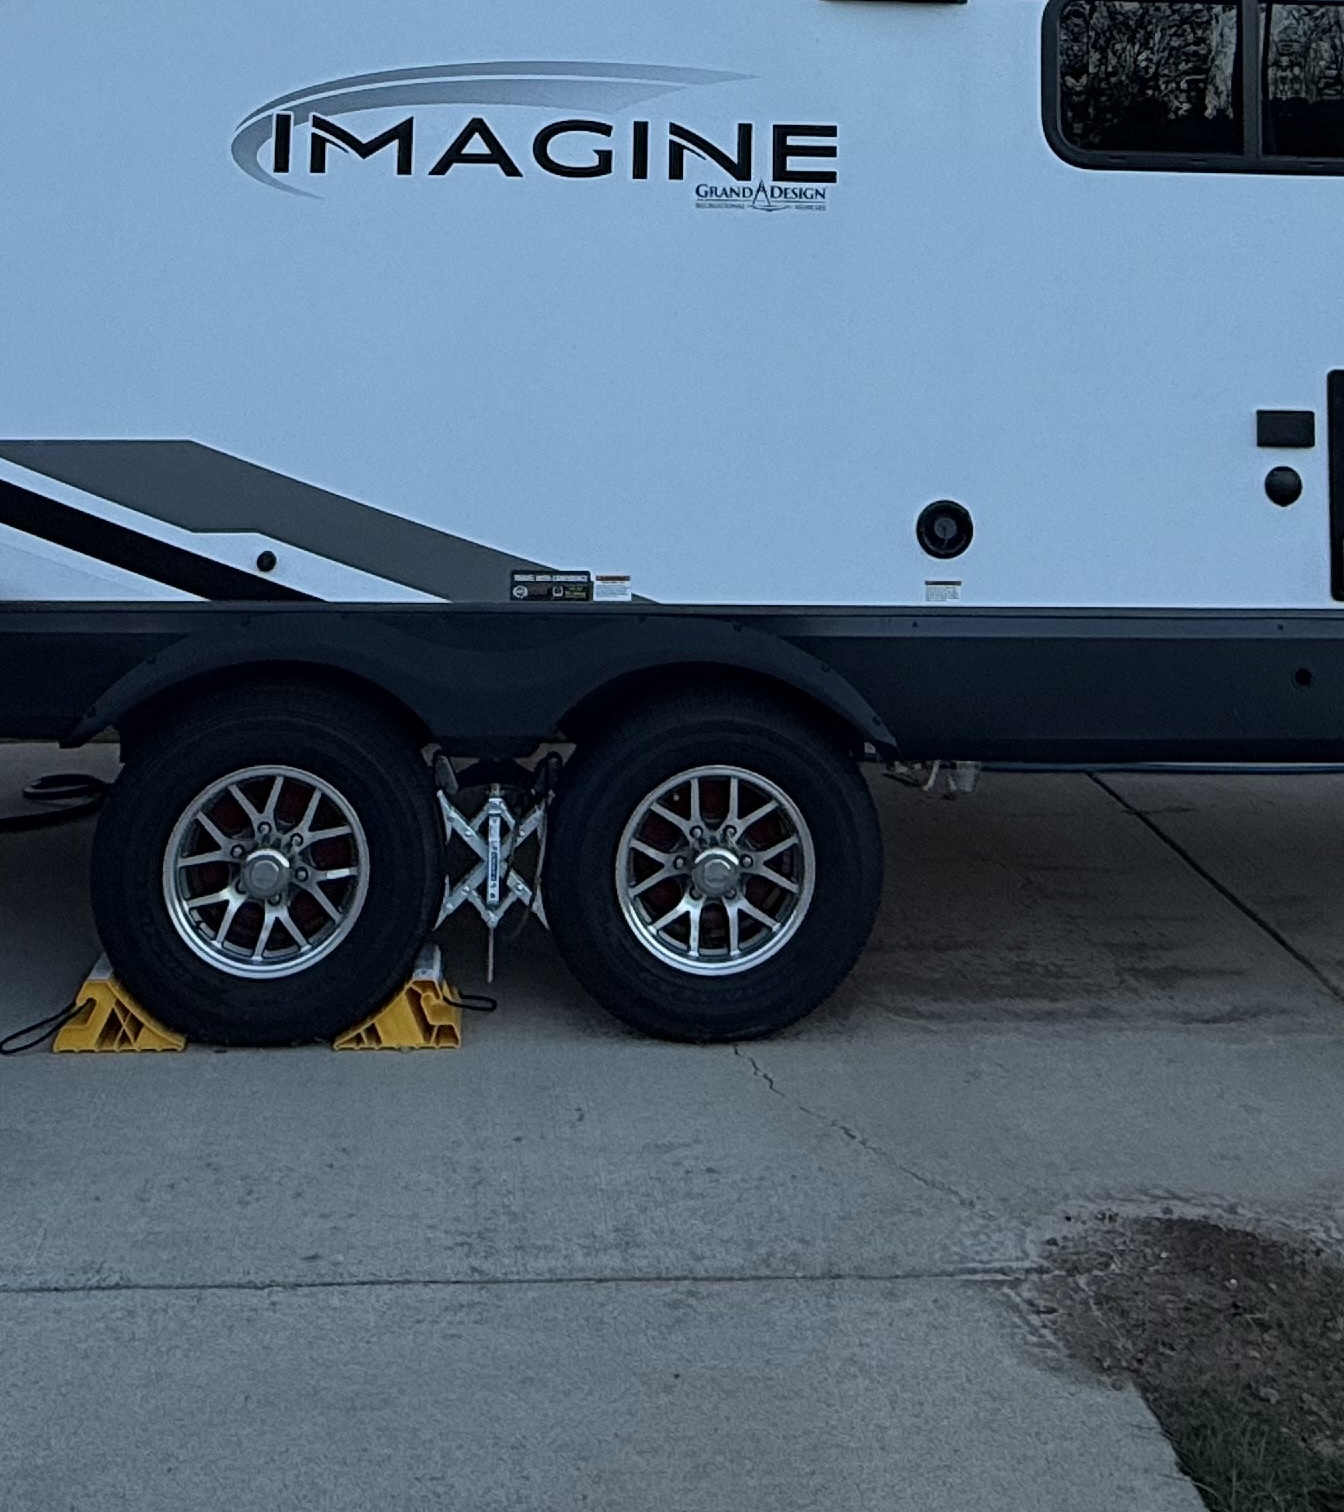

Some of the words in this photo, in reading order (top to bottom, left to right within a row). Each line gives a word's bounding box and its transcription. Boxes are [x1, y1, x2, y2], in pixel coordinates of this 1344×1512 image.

[272, 112, 838, 184] IMAGINE
[695, 183, 754, 199] GRAND
[770, 185, 826, 200] DESIGN
